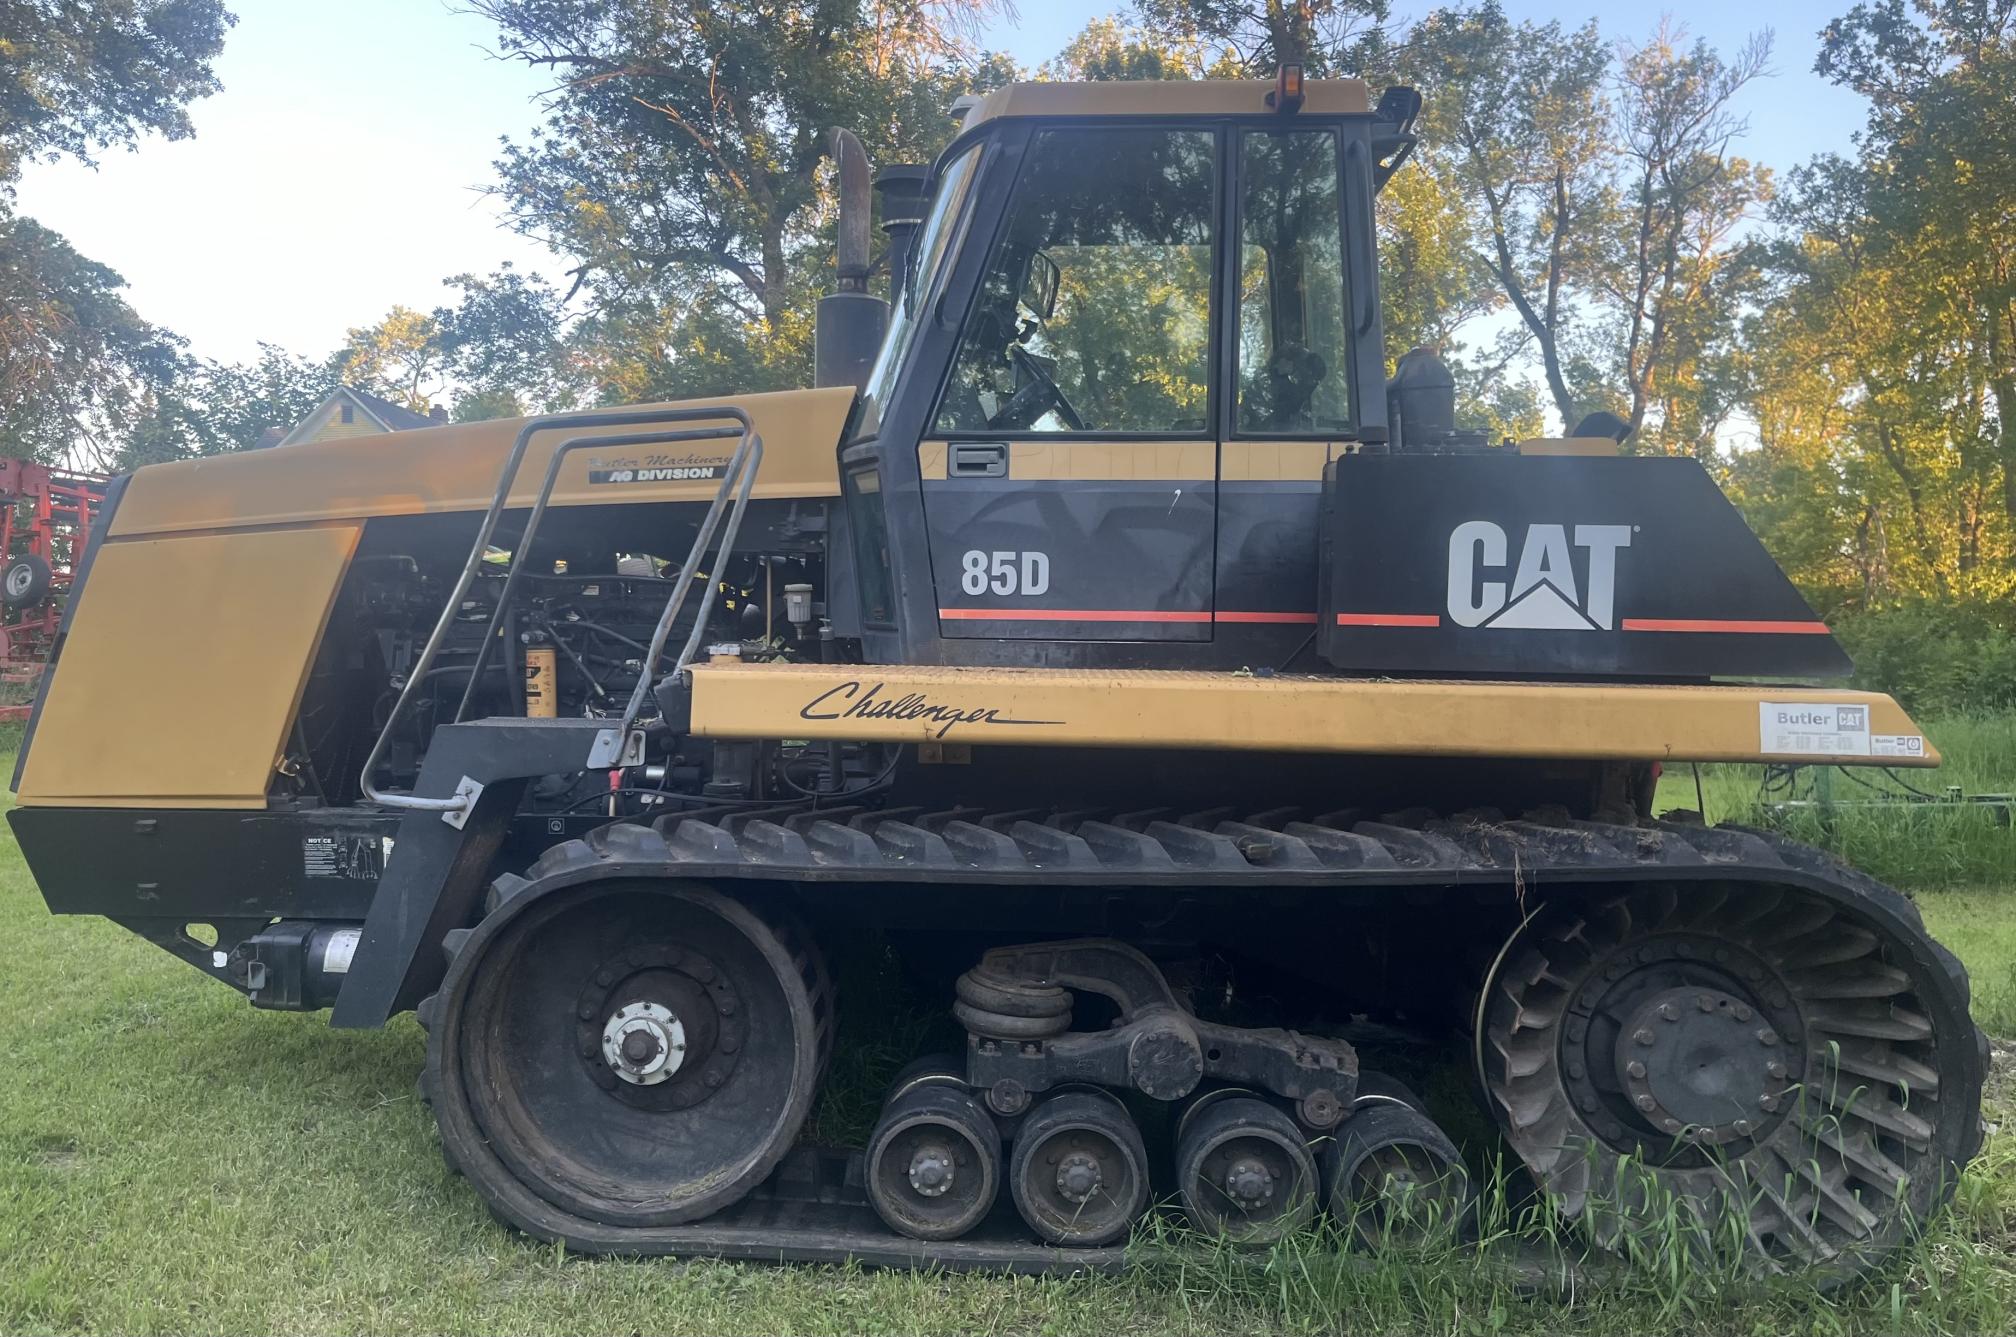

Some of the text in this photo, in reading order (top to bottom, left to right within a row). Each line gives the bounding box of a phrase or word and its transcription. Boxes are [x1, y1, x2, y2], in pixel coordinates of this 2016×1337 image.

[644, 452, 733, 467] Machinery
[609, 468, 714, 482] AG DIVISION
[962, 550, 1049, 595] 85D
[1447, 520, 1634, 631] CAT
[800, 681, 1066, 738] Challenger
[1777, 712, 1862, 726] Butler CAT
